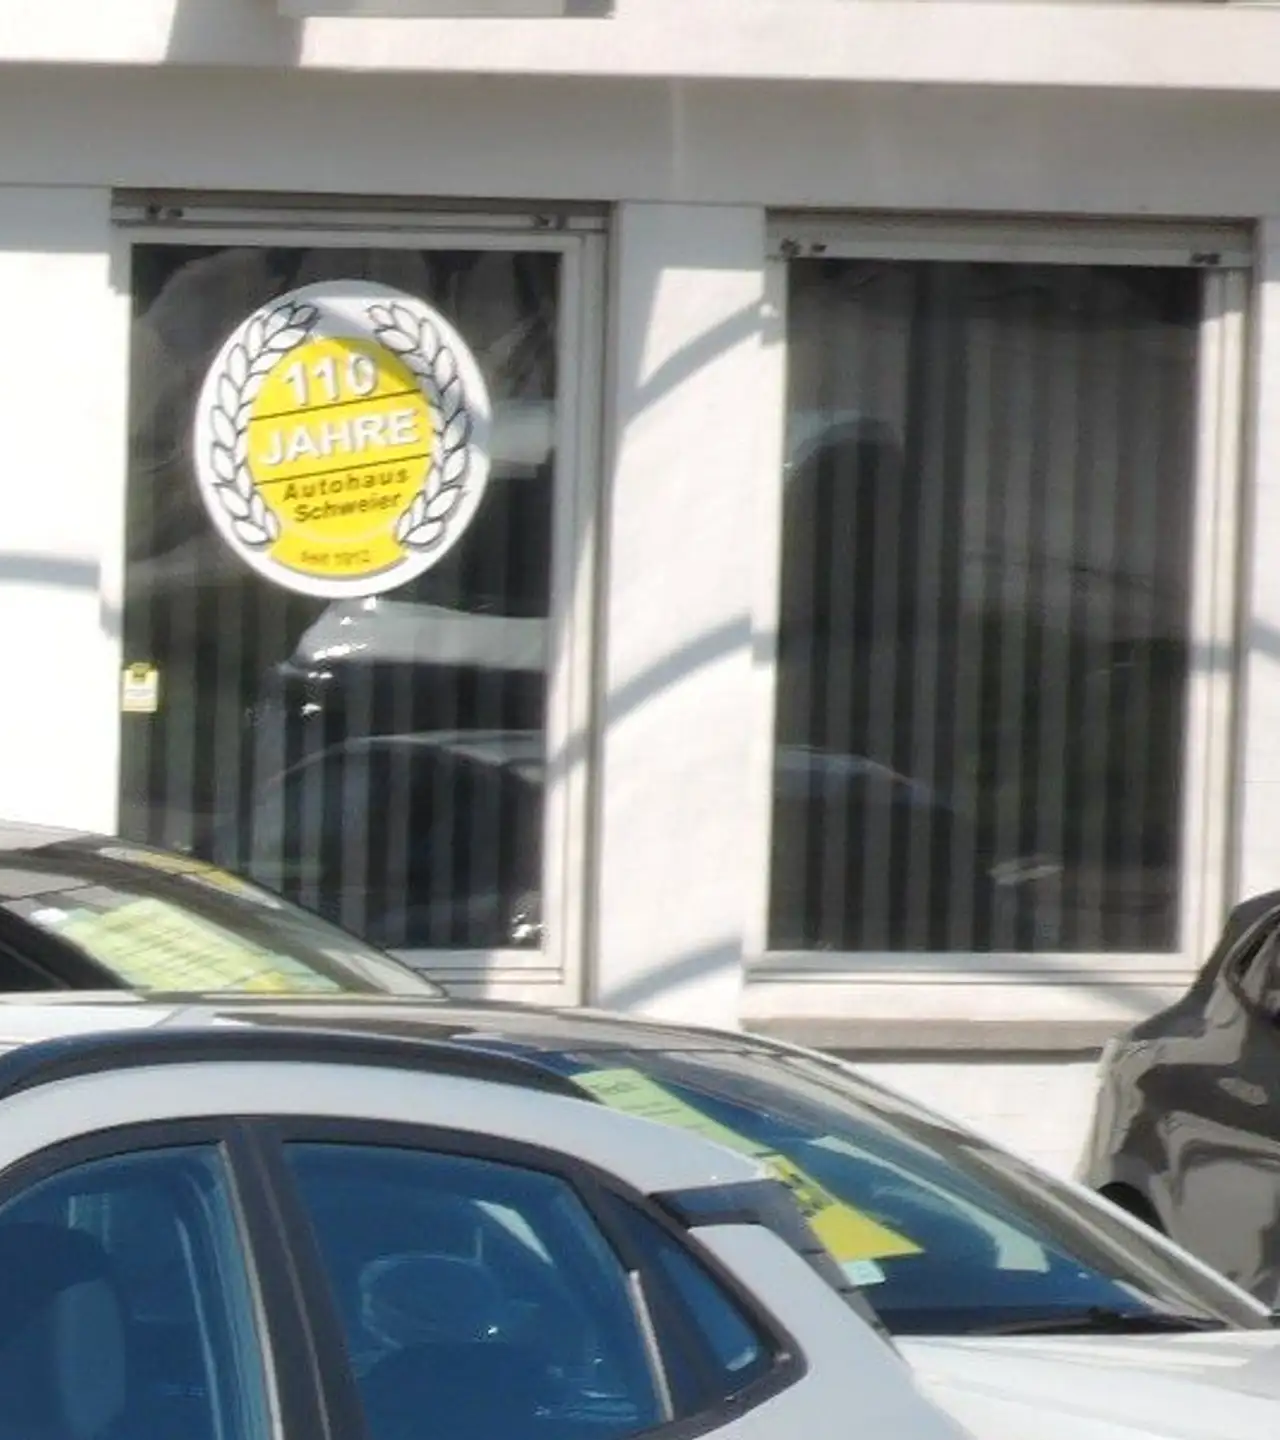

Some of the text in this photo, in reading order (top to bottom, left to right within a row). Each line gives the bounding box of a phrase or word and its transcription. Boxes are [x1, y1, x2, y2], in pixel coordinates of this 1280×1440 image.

[283, 353, 379, 407] 110
[260, 407, 420, 466] JAHRE
[283, 467, 409, 501] Autohaus
[294, 492, 402, 523] Schweier
